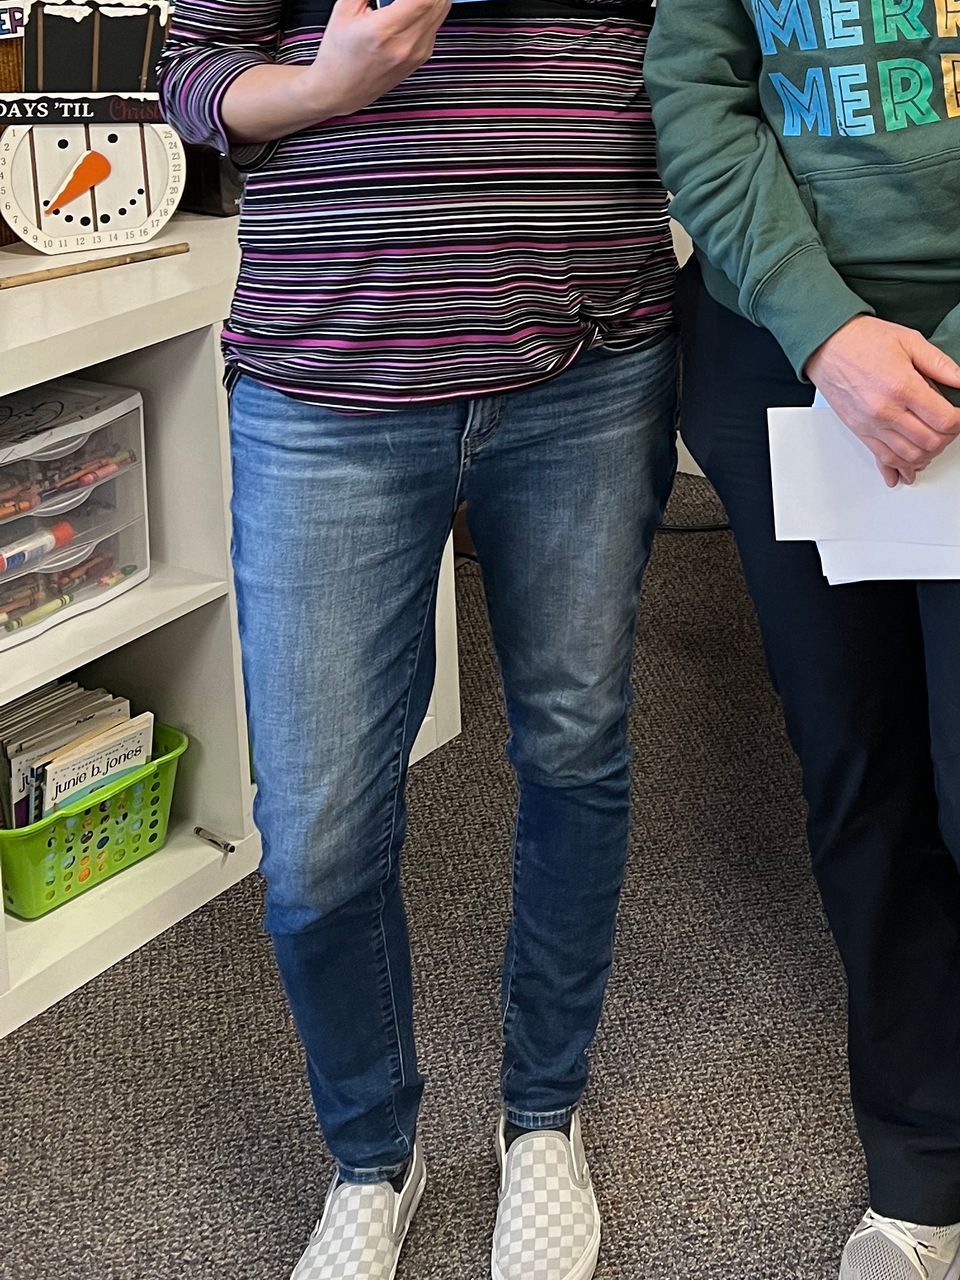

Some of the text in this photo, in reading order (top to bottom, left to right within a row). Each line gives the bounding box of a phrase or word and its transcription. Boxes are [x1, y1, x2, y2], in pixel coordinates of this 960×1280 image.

[54, 102, 94, 118] 'TIL
[12, 129, 16, 137] 1
[4, 143, 10, 151] 2
[169, 141, 178, 149] 24
[171, 152, 180, 160] 23
[0, 157, 6, 166] 3
[172, 163, 181, 172] 22
[172, 175, 180, 183] 21
[0, 186, 6, 195] 5
[169, 186, 178, 195] 20
[5, 202, 11, 210] 6
[166, 198, 175, 206] 19
[159, 209, 169, 217] 18
[13, 216, 18, 224] 7
[151, 219, 160, 227] 17
[23, 227, 28, 235] 8
[125, 231, 135, 239] 15
[139, 228, 149, 237] 16
[33, 235, 38, 243] 9
[92, 235, 102, 243] 13
[109, 233, 118, 241] 14
[43, 240, 53, 248] 10
[59, 240, 68, 248] 11
[76, 238, 85, 246] 12
[51, 771, 87, 801] junie
[102, 744, 144, 776] jones
